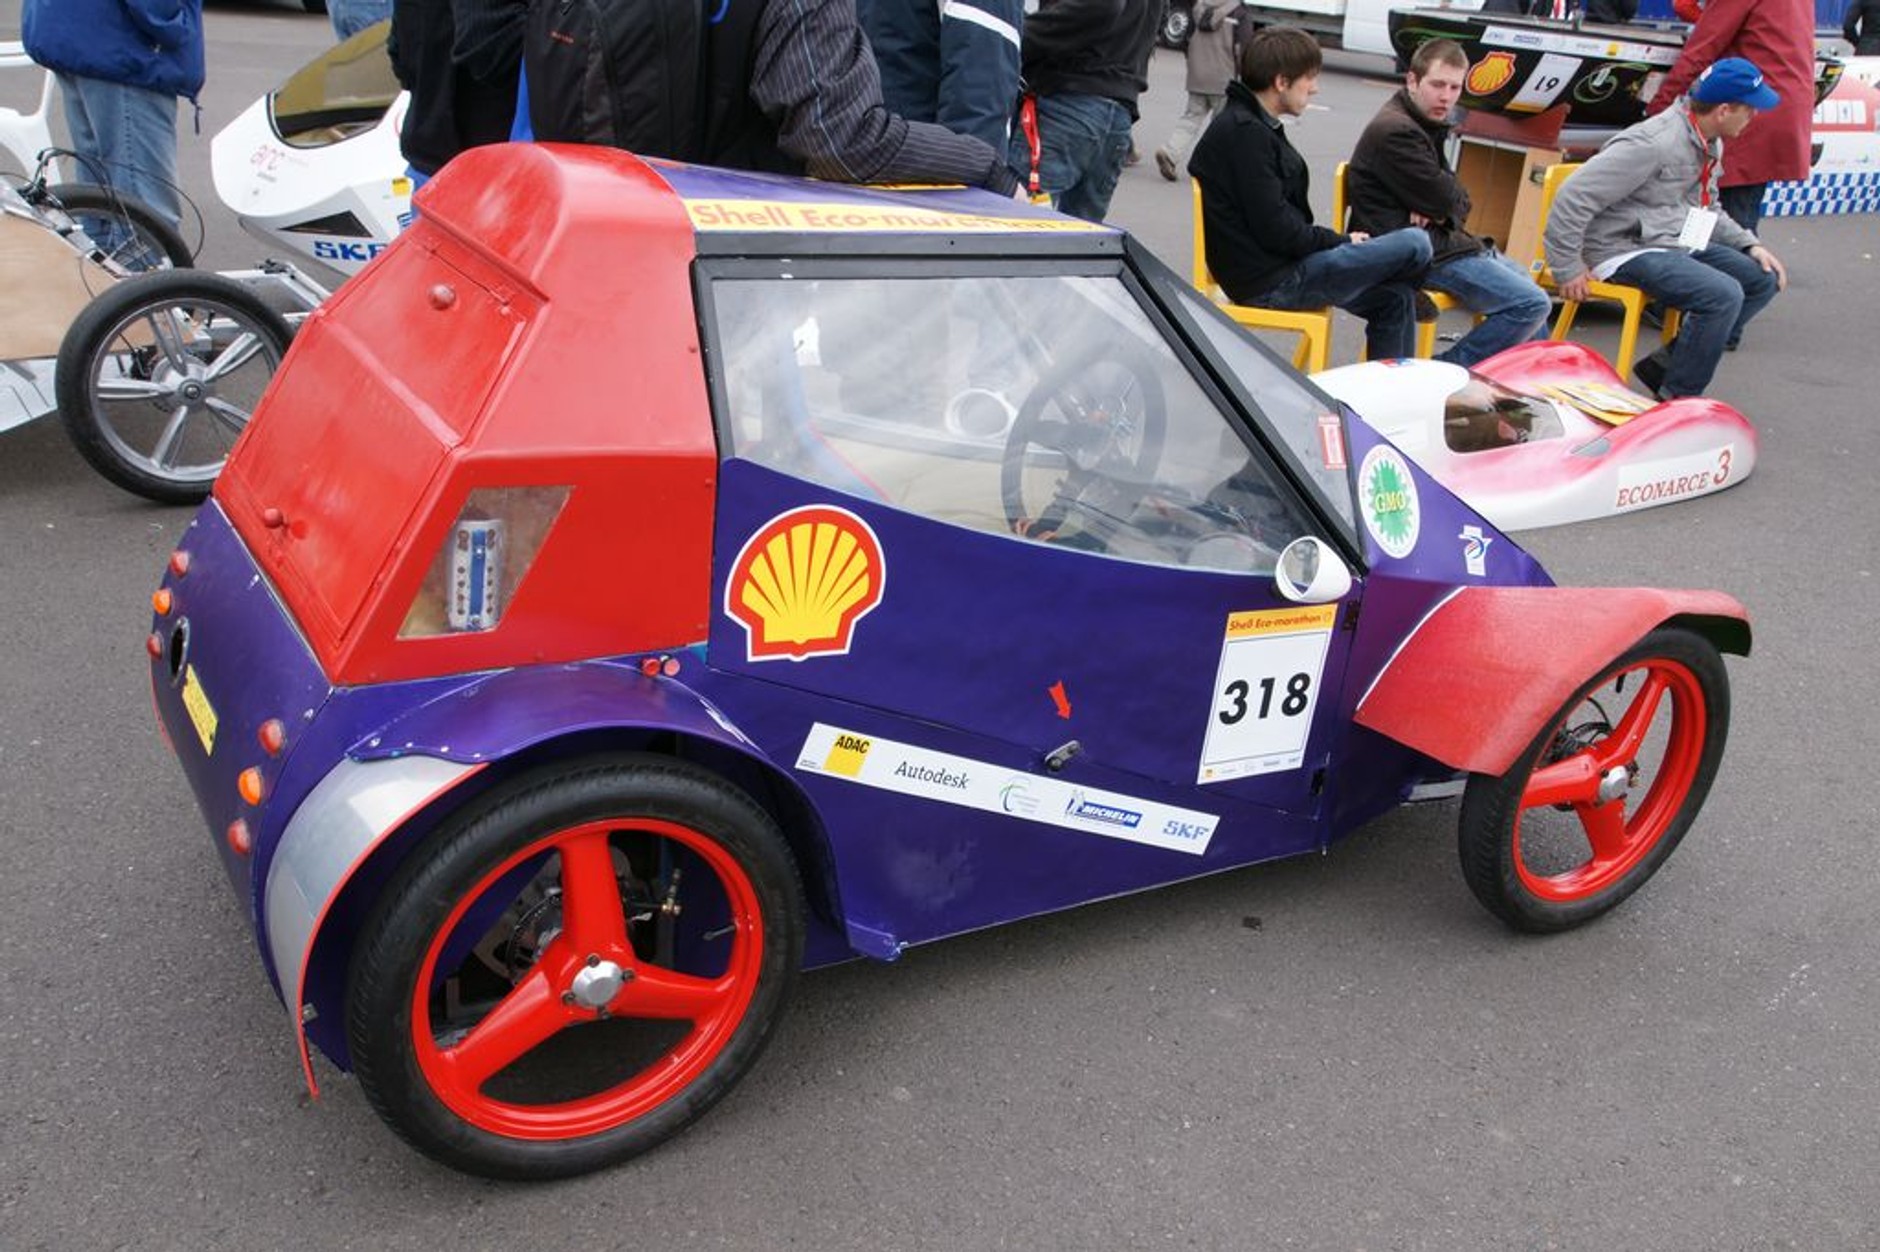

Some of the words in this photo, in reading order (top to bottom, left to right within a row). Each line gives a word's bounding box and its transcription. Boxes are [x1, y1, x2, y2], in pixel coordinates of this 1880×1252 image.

[692, 203, 792, 227] Shell
[1616, 472, 1710, 507] ECONARCE
[1713, 449, 1731, 485] 3
[1375, 491, 1406, 513] GMO
[1229, 618, 1253, 631] Shell
[1219, 672, 1311, 725] 318
[835, 735, 870, 754] ADAC
[894, 761, 970, 789] Autodesk
[1082, 805, 1139, 824] MICHELIN
[1162, 819, 1210, 840] SKF
